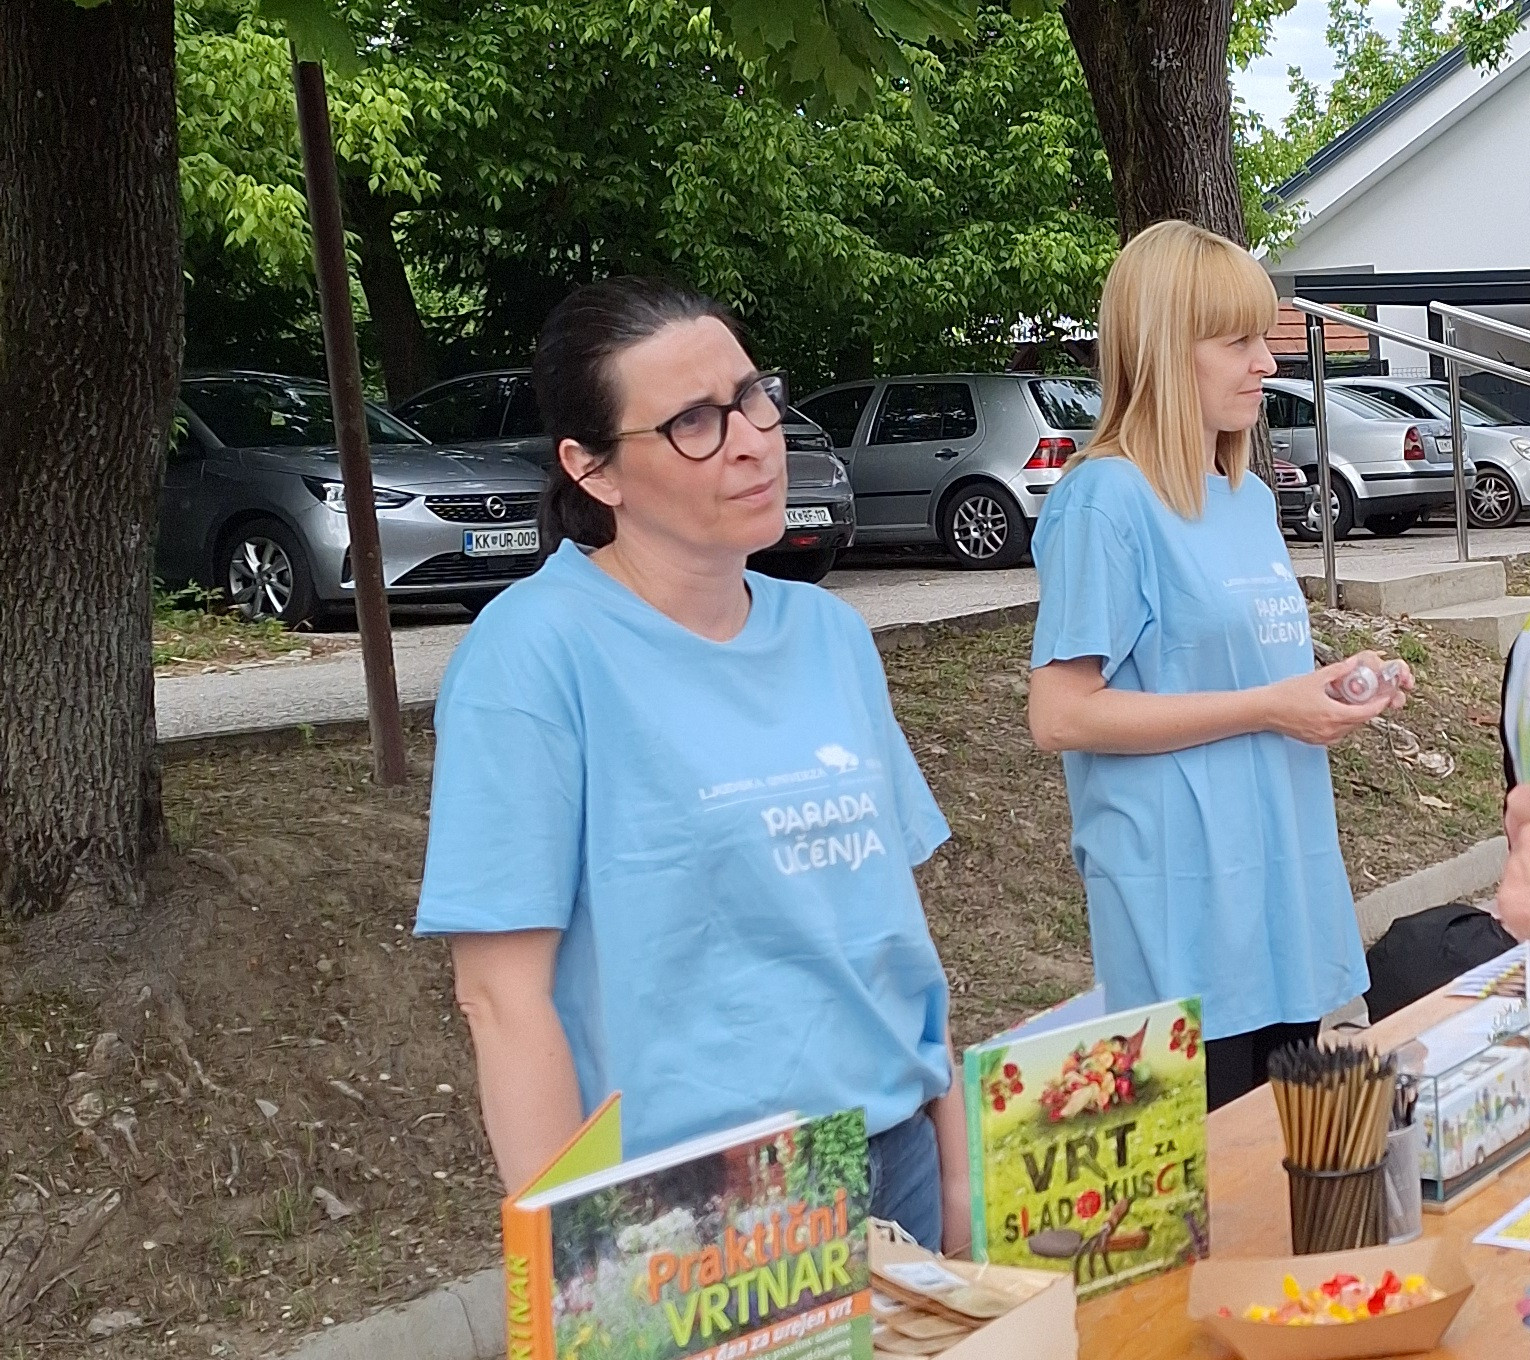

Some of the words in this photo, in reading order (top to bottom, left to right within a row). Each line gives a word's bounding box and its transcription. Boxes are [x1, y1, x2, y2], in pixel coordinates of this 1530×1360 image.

[475, 534, 490, 549] KK
[500, 531, 537, 547] UR-009
[762, 793, 878, 836] PARADA
[774, 830, 885, 875] UČENJA
[1023, 1122, 1136, 1193] VRT
[648, 1188, 847, 1304] Praktični
[665, 1240, 851, 1347] VRTNAR
